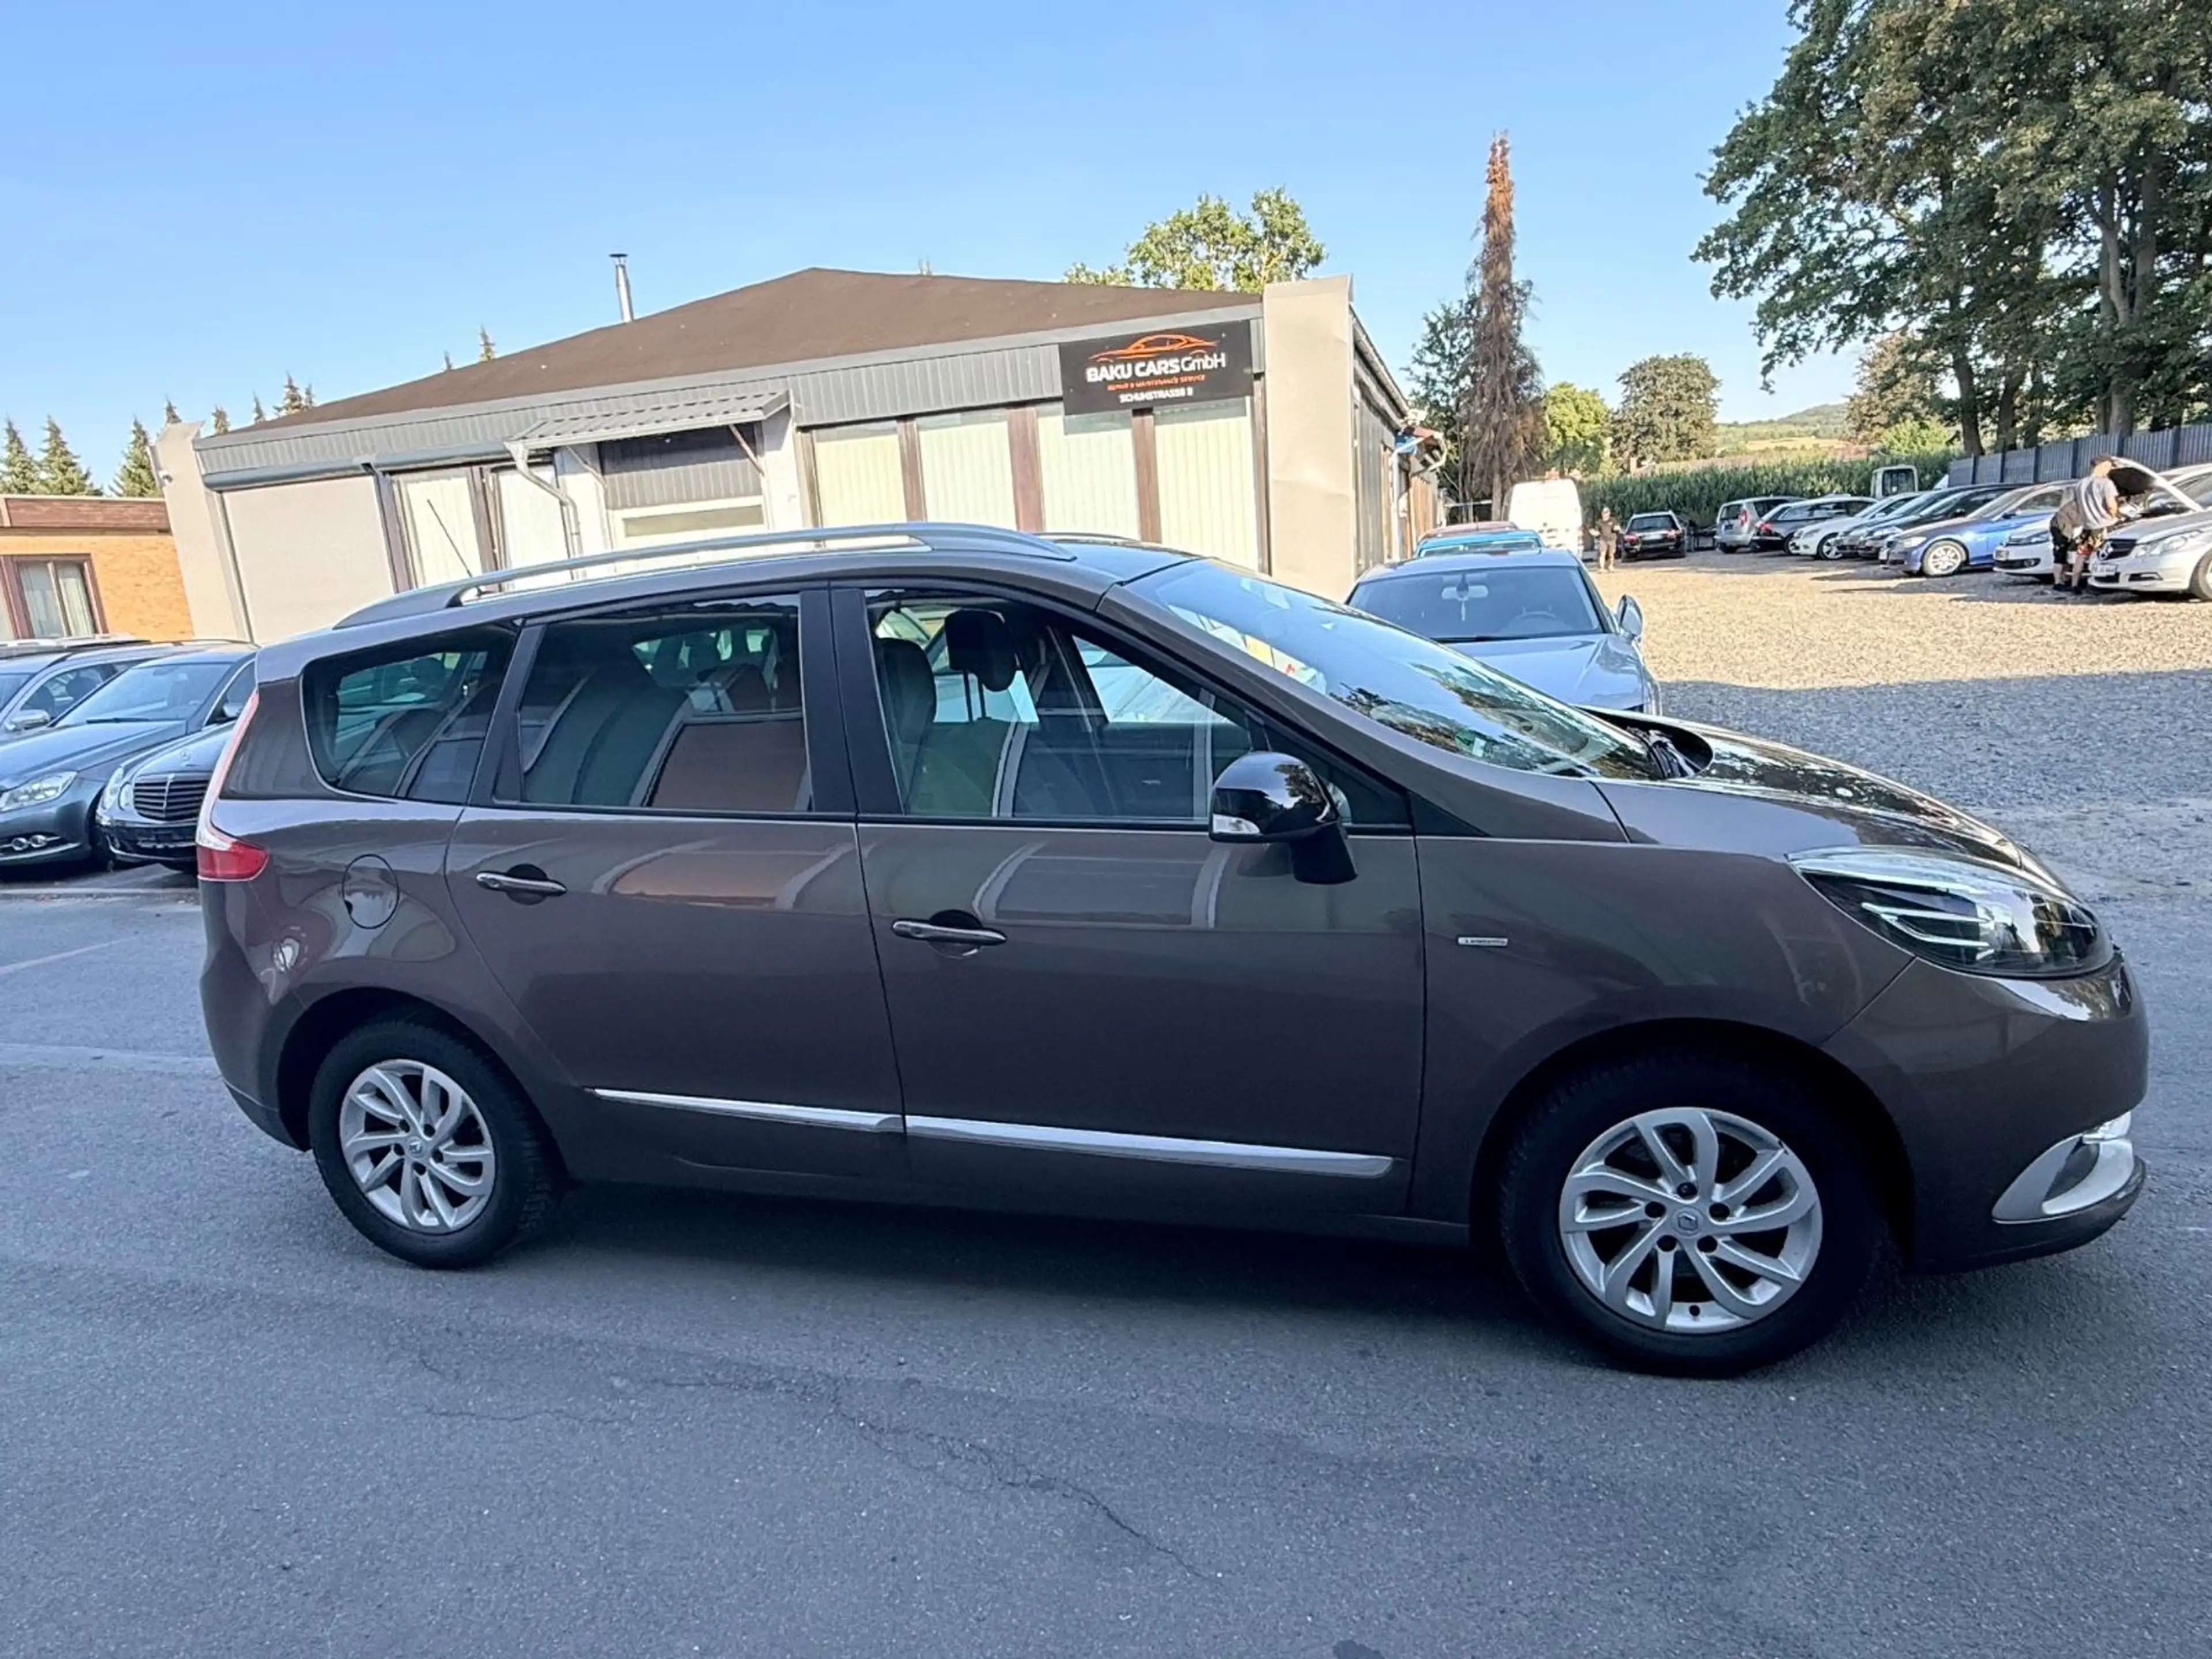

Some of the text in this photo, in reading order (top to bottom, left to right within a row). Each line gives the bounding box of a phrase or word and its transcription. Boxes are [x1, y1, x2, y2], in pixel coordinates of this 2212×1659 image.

[1086, 352, 1226, 382] BAKU CARS GmbH
